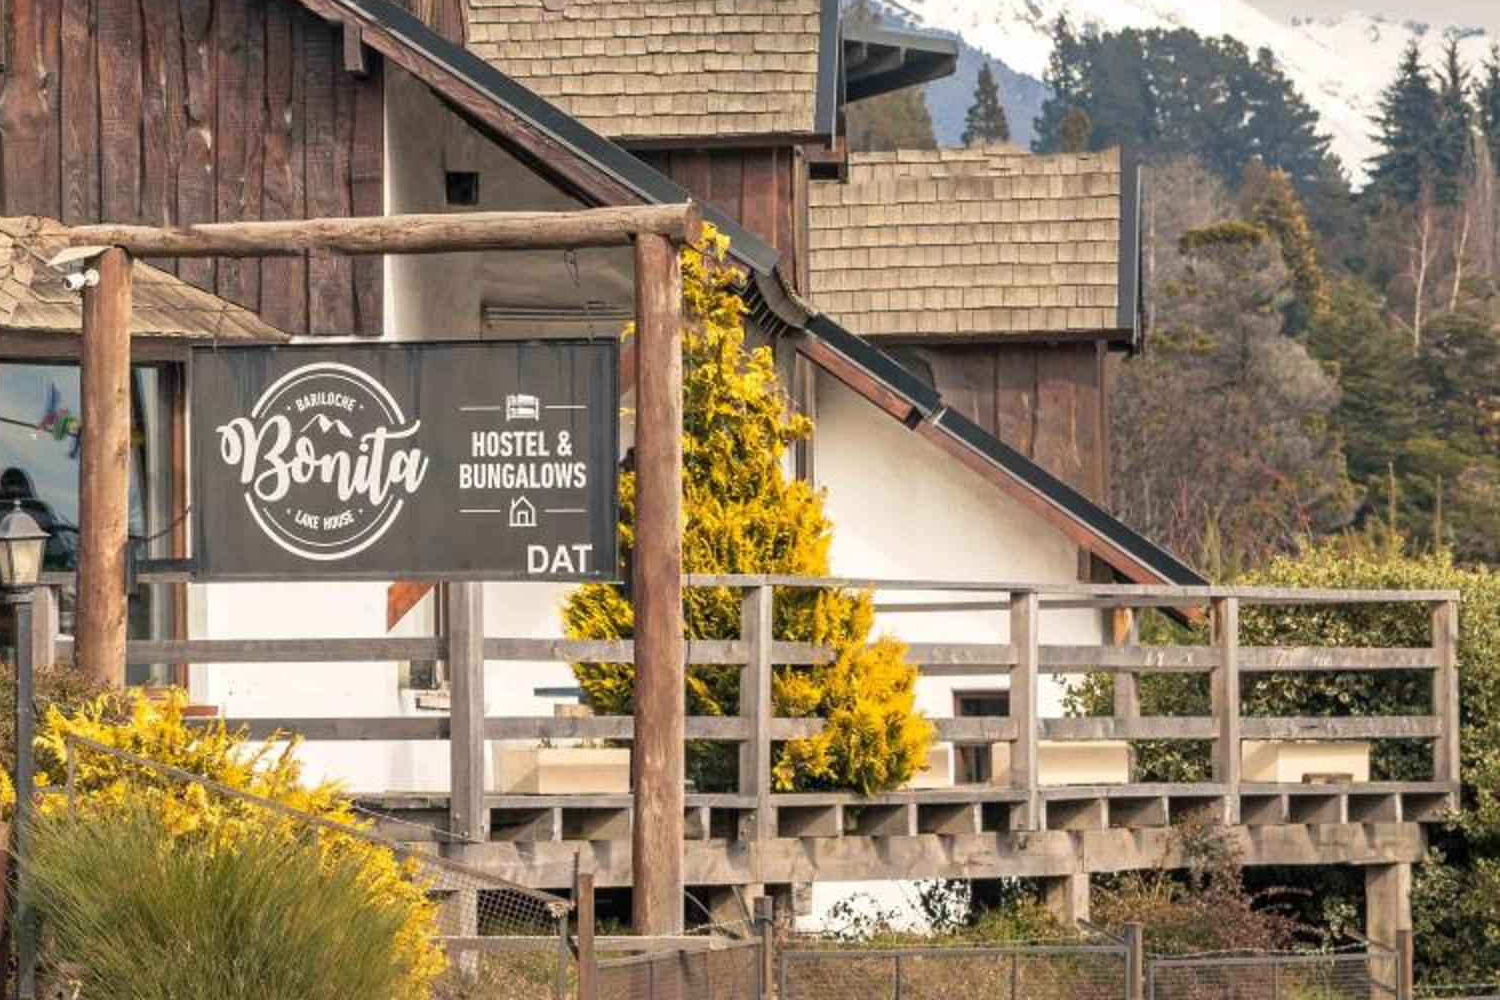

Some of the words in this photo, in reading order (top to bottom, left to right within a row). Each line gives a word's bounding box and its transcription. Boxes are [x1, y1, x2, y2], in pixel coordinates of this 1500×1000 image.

[295, 391, 357, 412] BARILOCHE
[471, 431, 550, 457] HOSTEL
[556, 430, 573, 457] &
[215, 414, 430, 507] Bonita
[458, 462, 588, 489] BUNGALOWS
[294, 509, 320, 531] LAKE
[322, 509, 356, 531] HOUSE
[527, 543, 593, 574] DAT
